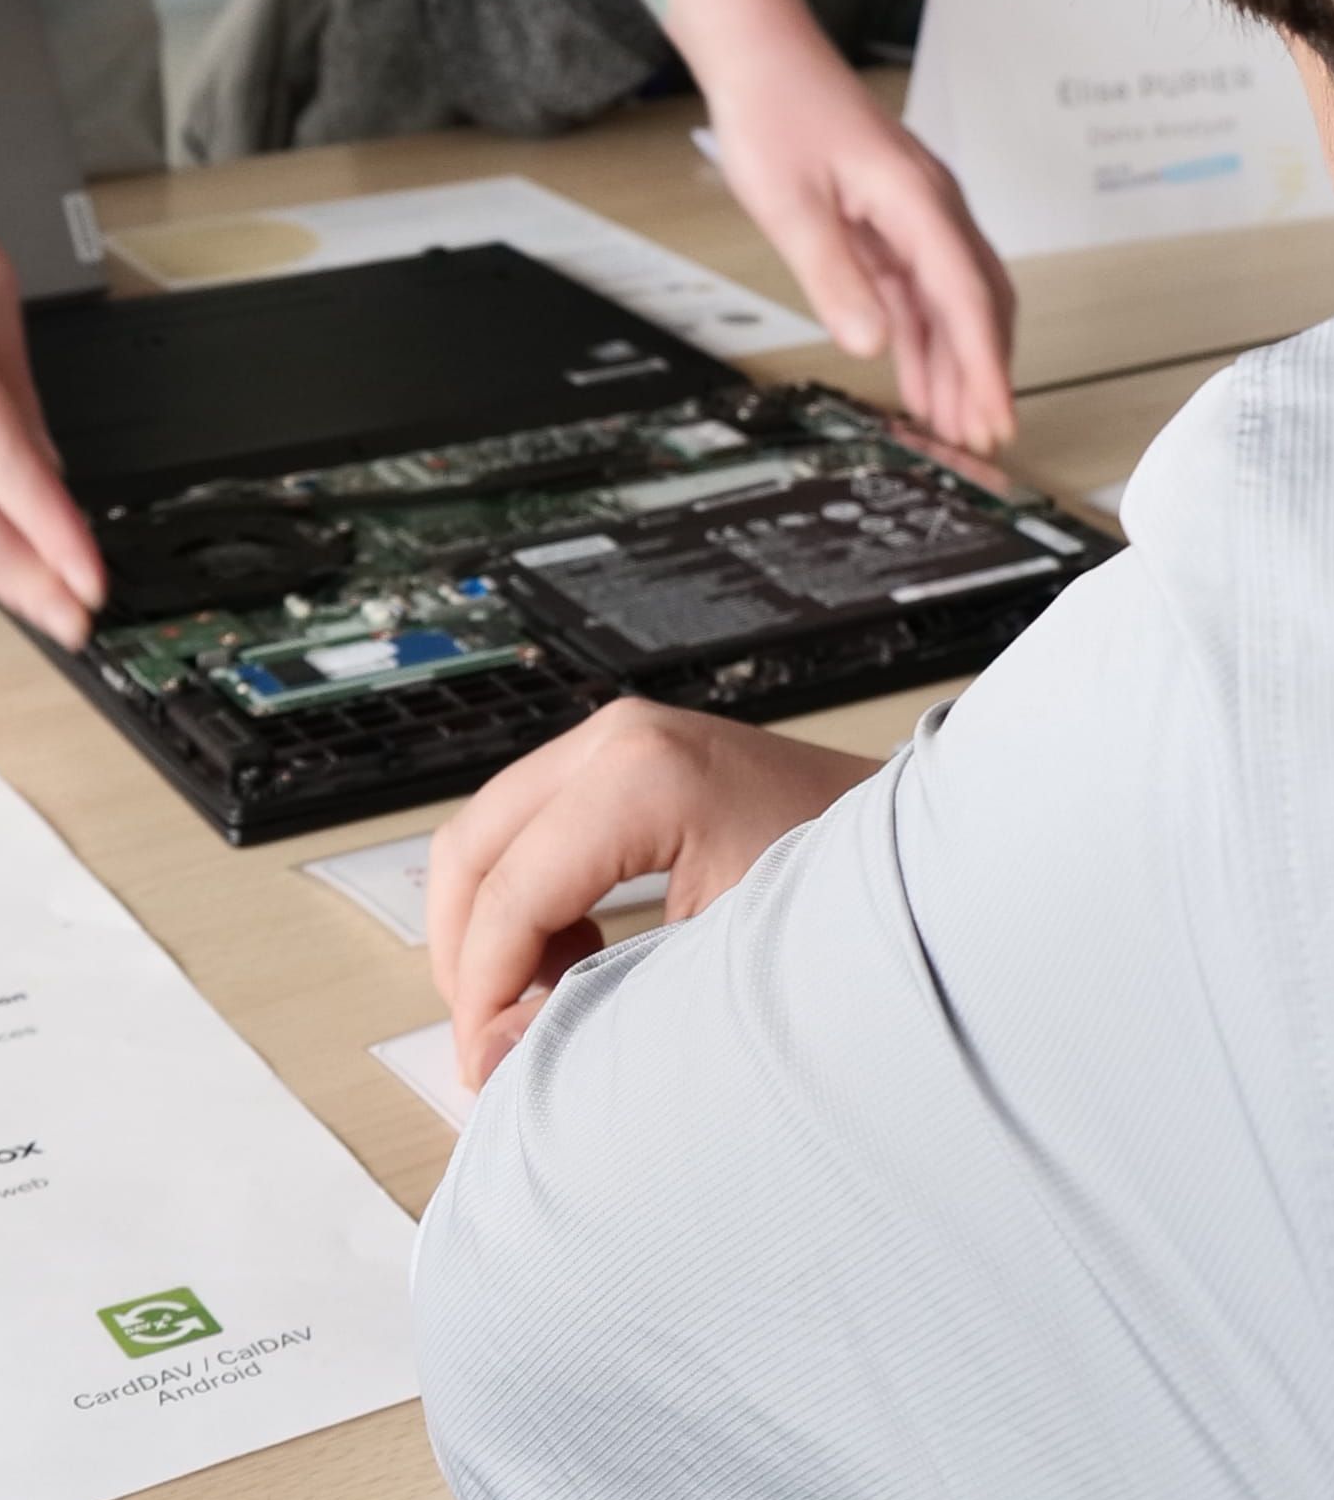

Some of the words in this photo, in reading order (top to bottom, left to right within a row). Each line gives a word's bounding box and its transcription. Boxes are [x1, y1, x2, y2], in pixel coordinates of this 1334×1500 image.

[74, 1361, 193, 1410] CardDAV
[217, 1326, 312, 1366] CalDAV
[158, 1361, 263, 1407] Android
